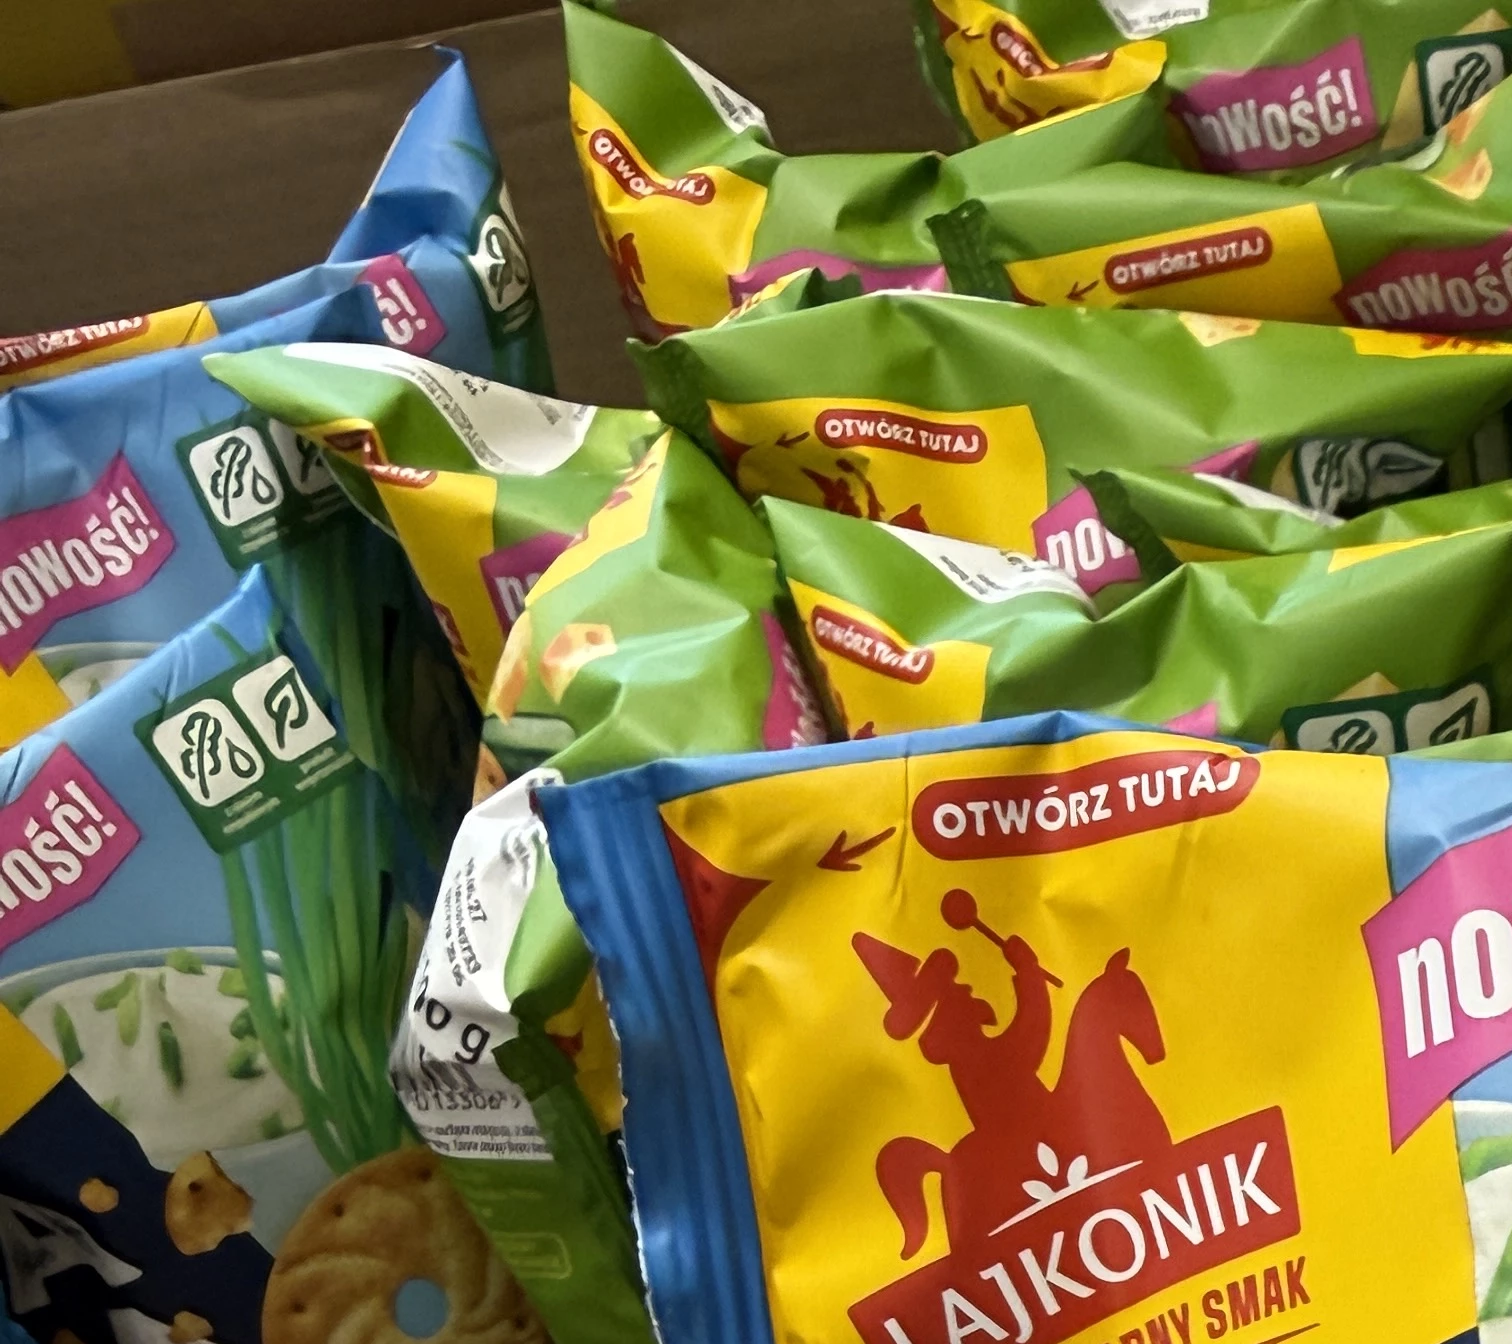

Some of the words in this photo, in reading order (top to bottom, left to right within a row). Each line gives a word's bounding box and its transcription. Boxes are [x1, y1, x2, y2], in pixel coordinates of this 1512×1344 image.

[1203, 236, 1264, 264] TUTAJ
[918, 429, 980, 454] TUTAJ
[931, 785, 1113, 840] OTWÓRZ
[1125, 757, 1242, 817] TUTAJ
[455, 1023, 490, 1065] g
[1203, 1255, 1312, 1340] SMAK
